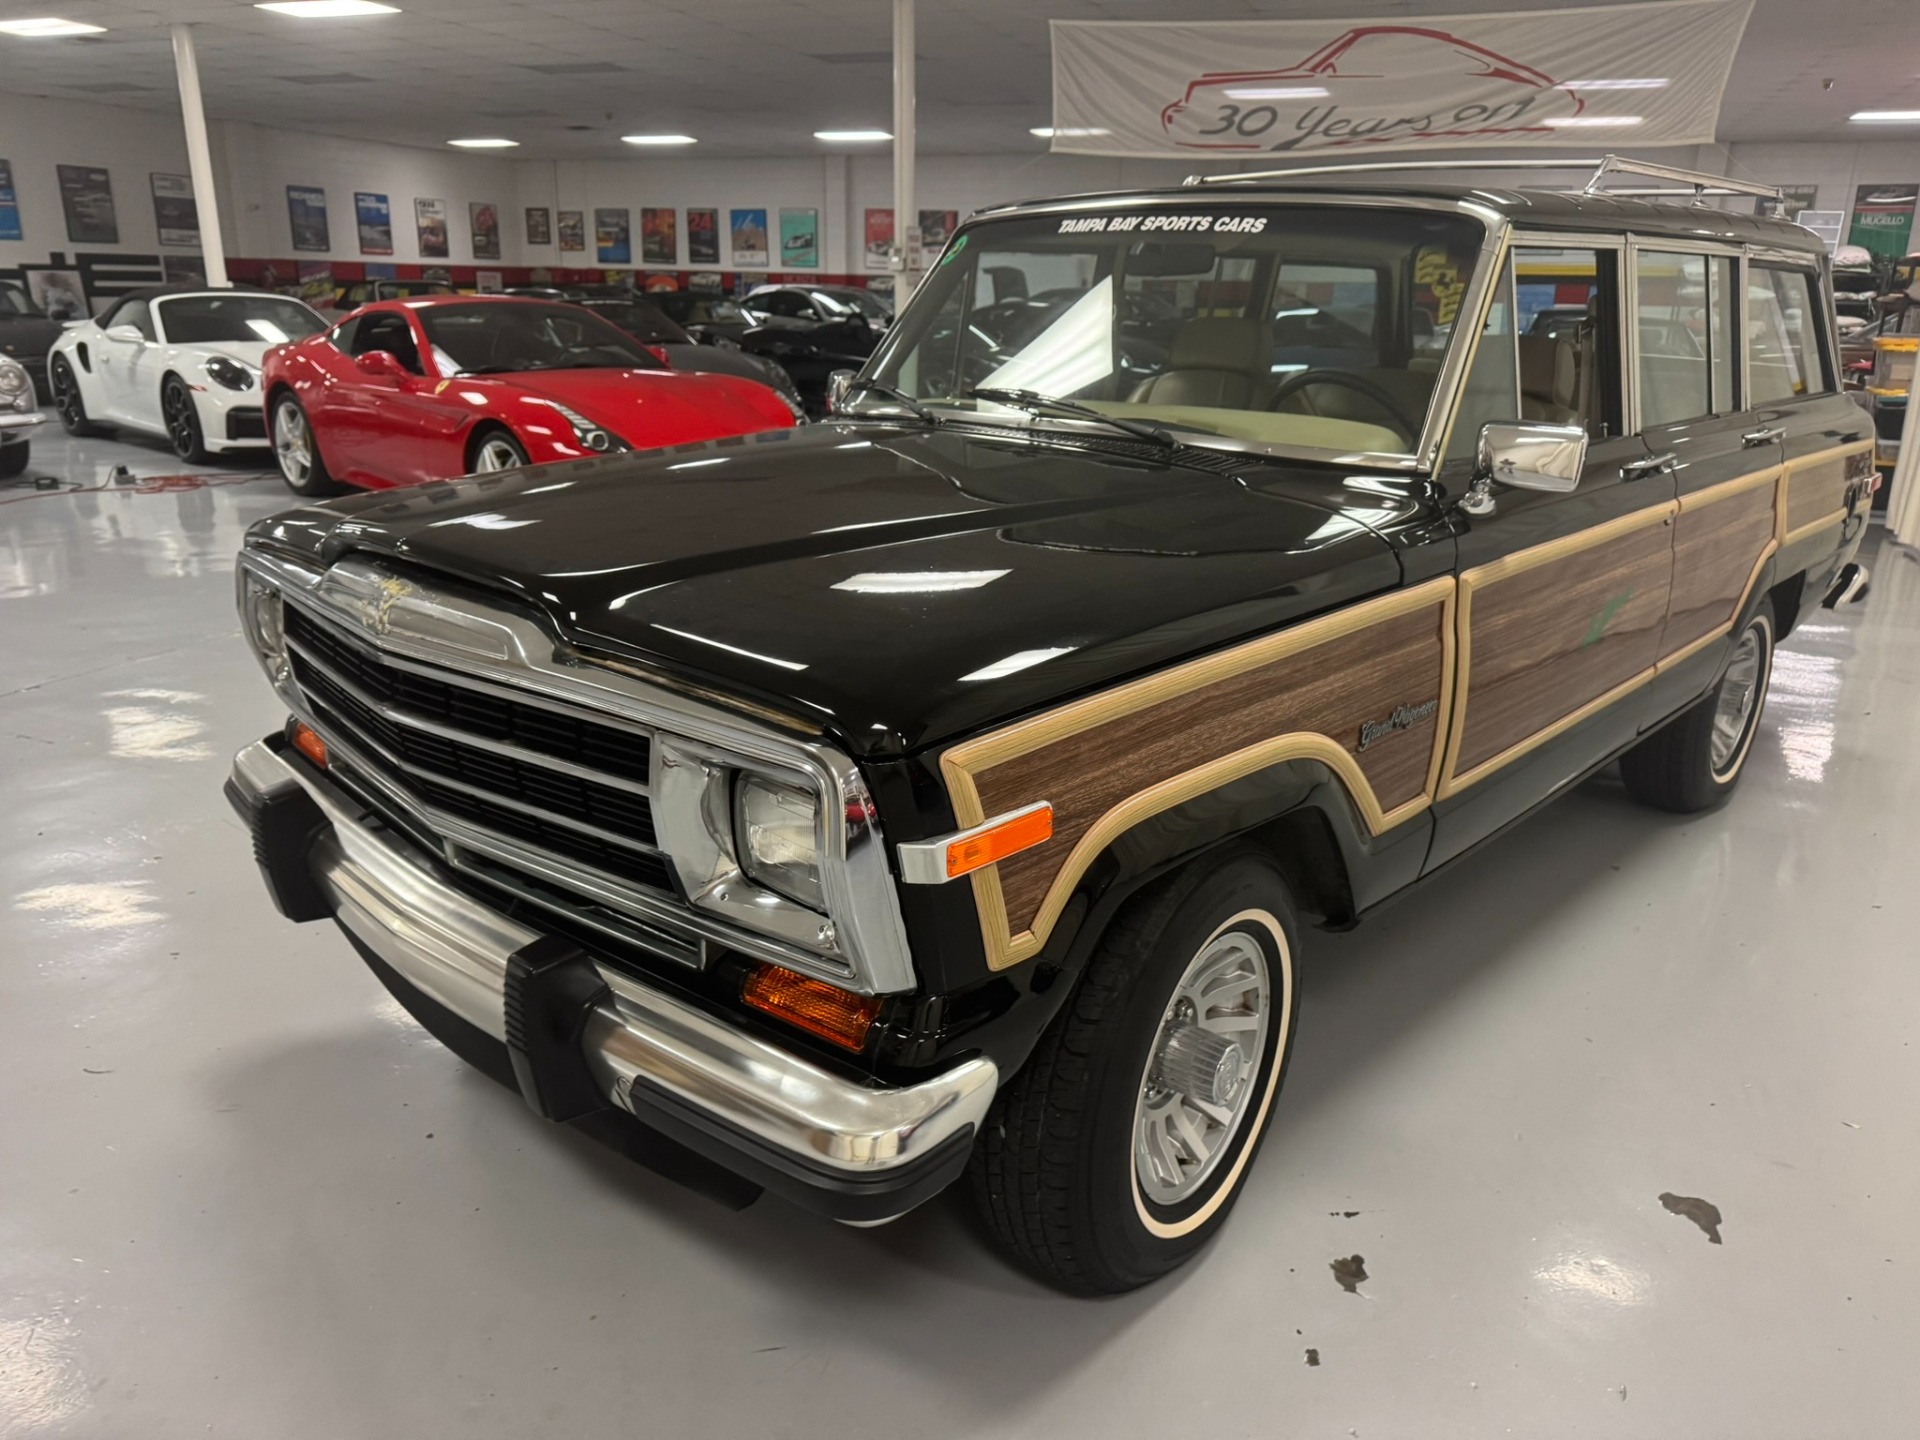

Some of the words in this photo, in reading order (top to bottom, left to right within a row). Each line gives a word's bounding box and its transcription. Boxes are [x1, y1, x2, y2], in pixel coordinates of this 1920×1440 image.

[1199, 104, 1278, 137] 30
[1270, 105, 1432, 151] Years
[689, 213, 712, 231] 24
[1057, 217, 1108, 234] TAMPA
[1107, 216, 1144, 231] BAY
[1140, 216, 1213, 231] SPORTS
[1213, 217, 1268, 233] CARS
[1860, 215, 1905, 226] MUGELLO
[1357, 712, 1396, 752] Grand
